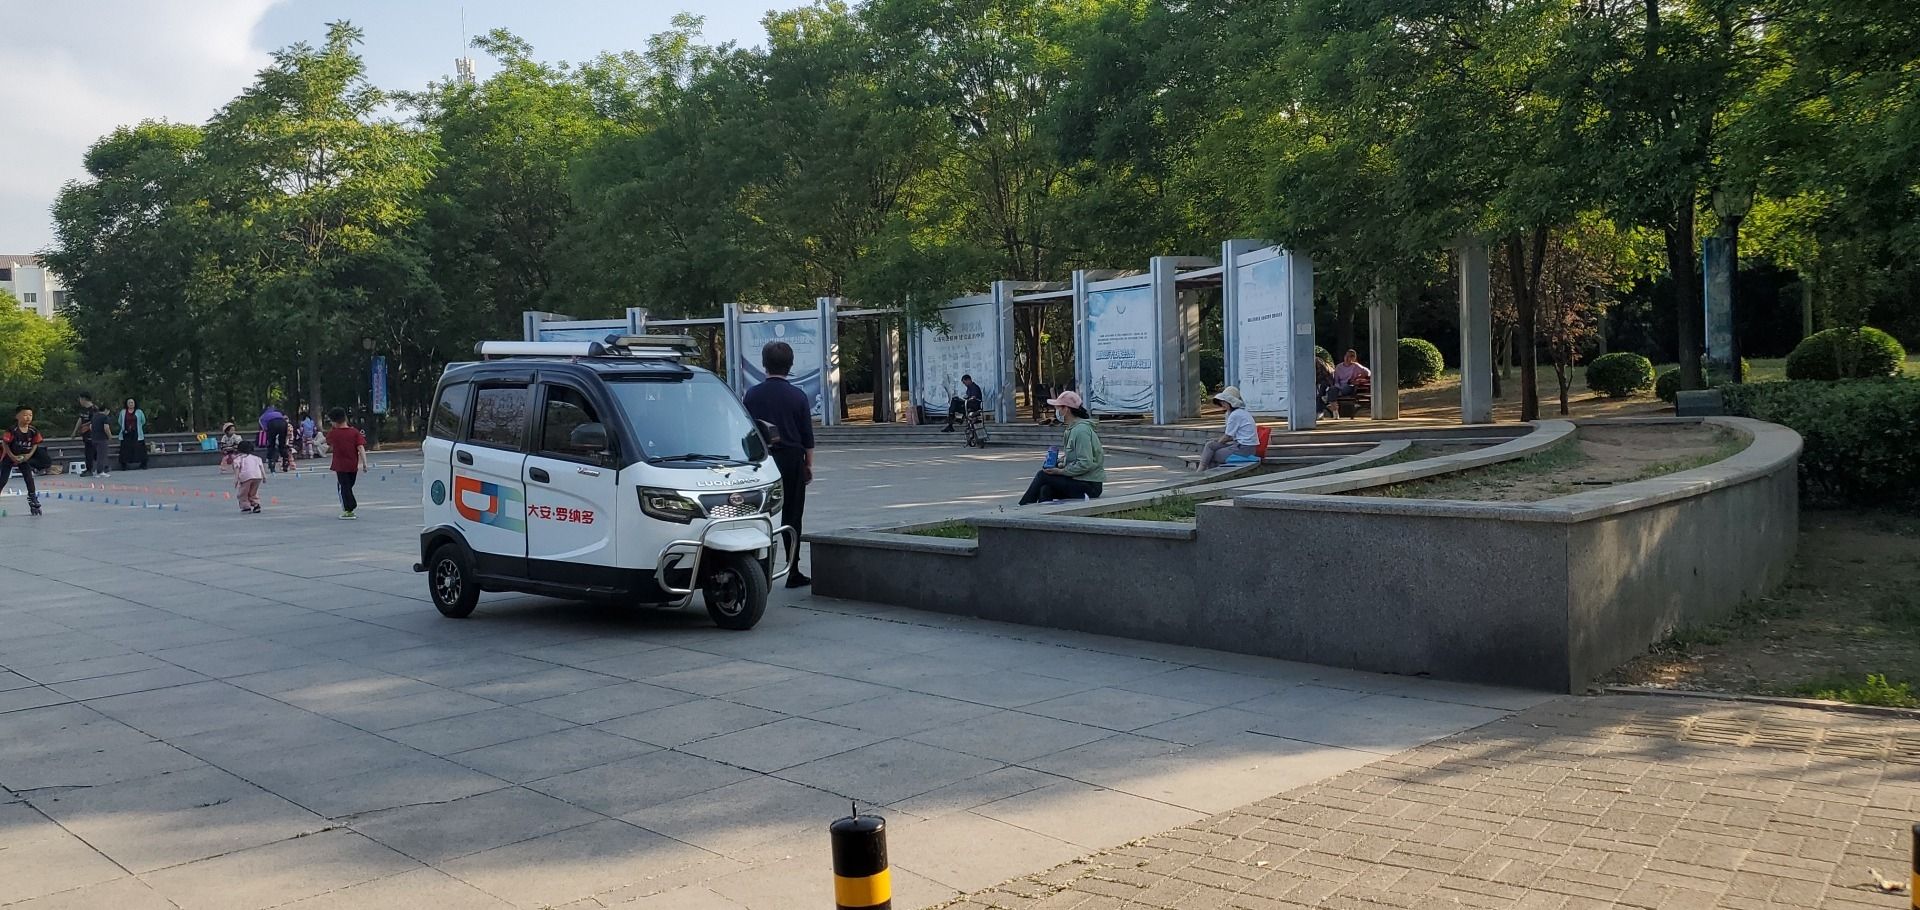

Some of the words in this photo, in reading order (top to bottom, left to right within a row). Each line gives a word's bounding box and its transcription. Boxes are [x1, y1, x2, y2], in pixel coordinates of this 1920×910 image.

[528, 504, 594, 524] 大安·罗纳多
